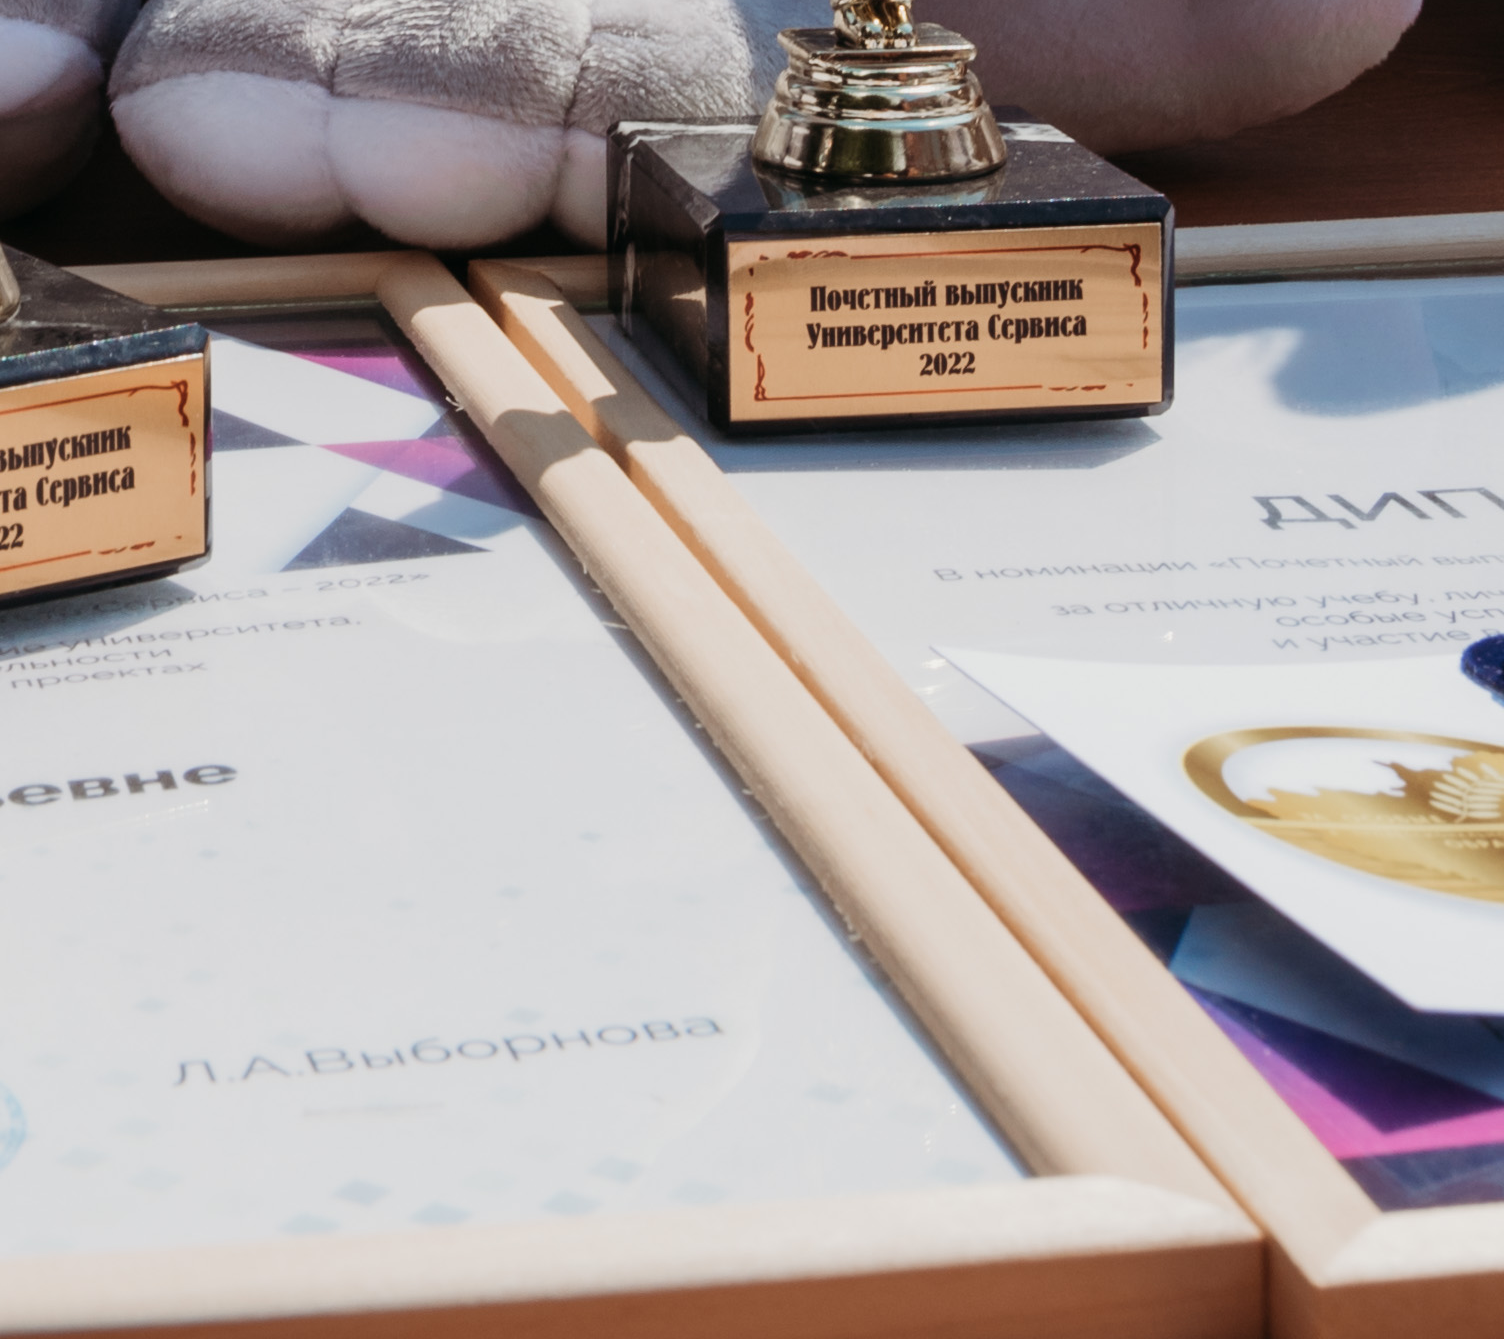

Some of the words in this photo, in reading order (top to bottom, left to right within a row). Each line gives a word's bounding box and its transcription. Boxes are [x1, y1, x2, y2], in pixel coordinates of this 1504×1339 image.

[810, 281, 937, 312] Почетный
[945, 278, 1083, 309] выпускник
[806, 321, 979, 350] Университета
[988, 314, 1088, 344] Сервиса
[919, 352, 976, 377] 2022
[35, 465, 135, 508] Сервиса
[315, 570, 430, 593] 2022»
[934, 568, 963, 582] В
[974, 560, 1198, 581] номинации
[1209, 554, 1422, 572] «Почетный
[1050, 603, 1095, 616] за
[1105, 594, 1297, 614] отличную
[1276, 607, 1427, 628] особые
[1272, 636, 1299, 650] и
[1309, 627, 1471, 652] участие
[10, 660, 208, 691] проектах
[173, 1014, 726, 1087] Л.А.Выборнова
